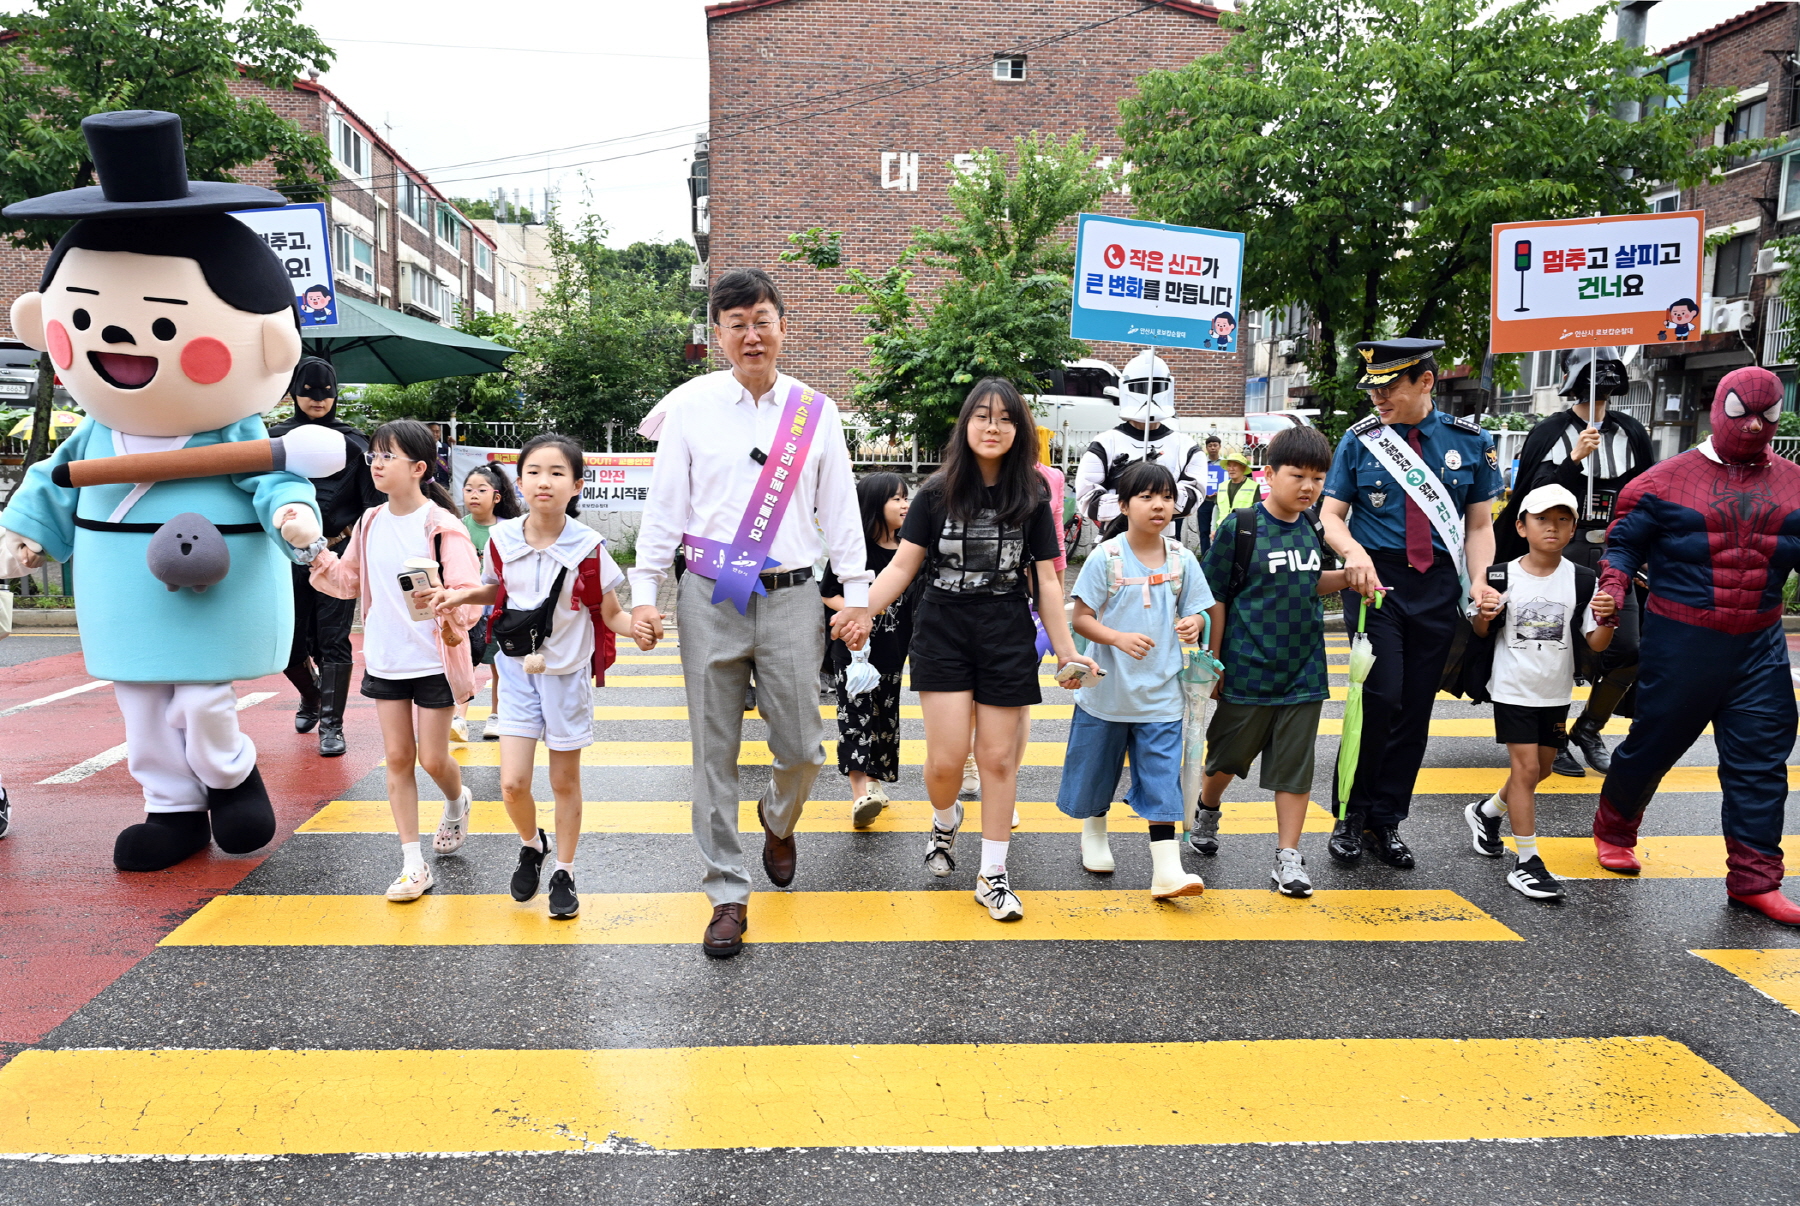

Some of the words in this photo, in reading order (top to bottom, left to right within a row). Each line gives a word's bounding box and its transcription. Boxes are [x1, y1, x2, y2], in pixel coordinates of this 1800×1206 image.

[281, 257, 312, 278] 요!
[1129, 249, 1164, 273] 작은
[1168, 253, 1219, 279] 신고가
[1542, 247, 1609, 273] 멈추고
[1615, 242, 1681, 269] 살피고
[1086, 273, 1104, 295] 큰
[1108, 274, 1161, 301] 변화를
[1165, 281, 1233, 308] 만듭니다
[1577, 274, 1644, 300] 건너요
[1139, 327, 1155, 336] 안산시
[1156, 328, 1186, 338] 로보캅순찰대
[1574, 329, 1594, 338] 안산시
[1595, 327, 1634, 336] 로보캅순찰대
[589, 457, 612, 466] OUT!
[781, 442, 797, 467] 우리
[599, 470, 625, 483] 안전
[770, 466, 789, 493] 함께
[580, 487, 608, 500] 에서
[748, 493, 778, 542] 만들어요
[1267, 549, 1321, 574] FILA
